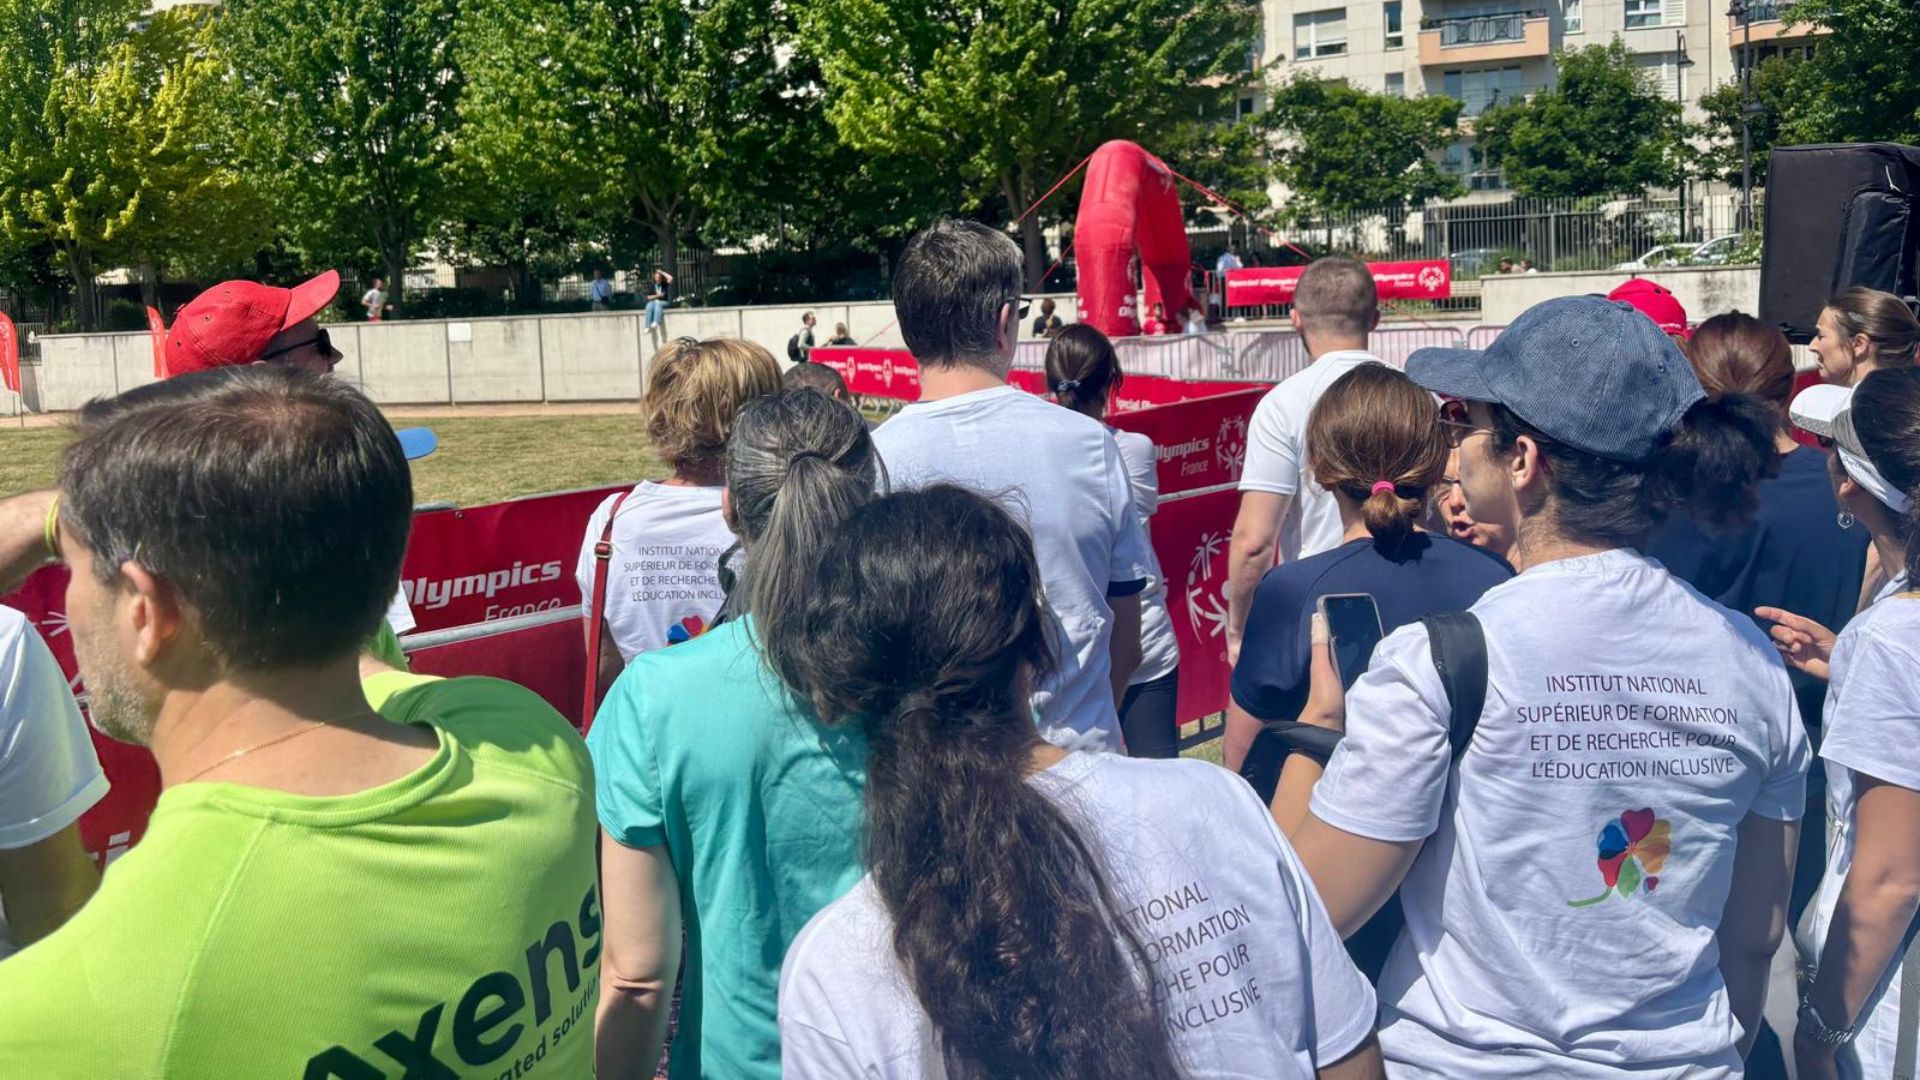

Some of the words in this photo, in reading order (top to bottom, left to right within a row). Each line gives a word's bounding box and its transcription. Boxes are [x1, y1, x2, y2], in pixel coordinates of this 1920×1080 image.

[1181, 460, 1209, 477] France
[639, 546, 683, 557] INSTITUT
[624, 560, 676, 572] SUPÉRIEUR
[678, 561, 693, 571] DE
[630, 576, 639, 587] ET
[642, 576, 656, 586] DE
[658, 575, 718, 586] RECHERCHE
[1546, 675, 1623, 693] INSTITUT
[1627, 676, 1707, 695] NATIONAL
[1517, 702, 1613, 723] SUPÉRIEUR
[1616, 704, 1639, 721] DE
[1643, 704, 1738, 725] FORMATION
[1530, 734, 1552, 751] ET
[1558, 734, 1582, 751] DE
[1587, 731, 1681, 751] RECHERCHE
[1686, 732, 1737, 748] POUR
[1532, 759, 1647, 780] L'ÉDUCATION
[1651, 756, 1735, 778] INCLUSIVE
[1198, 943, 1251, 984] POUR
